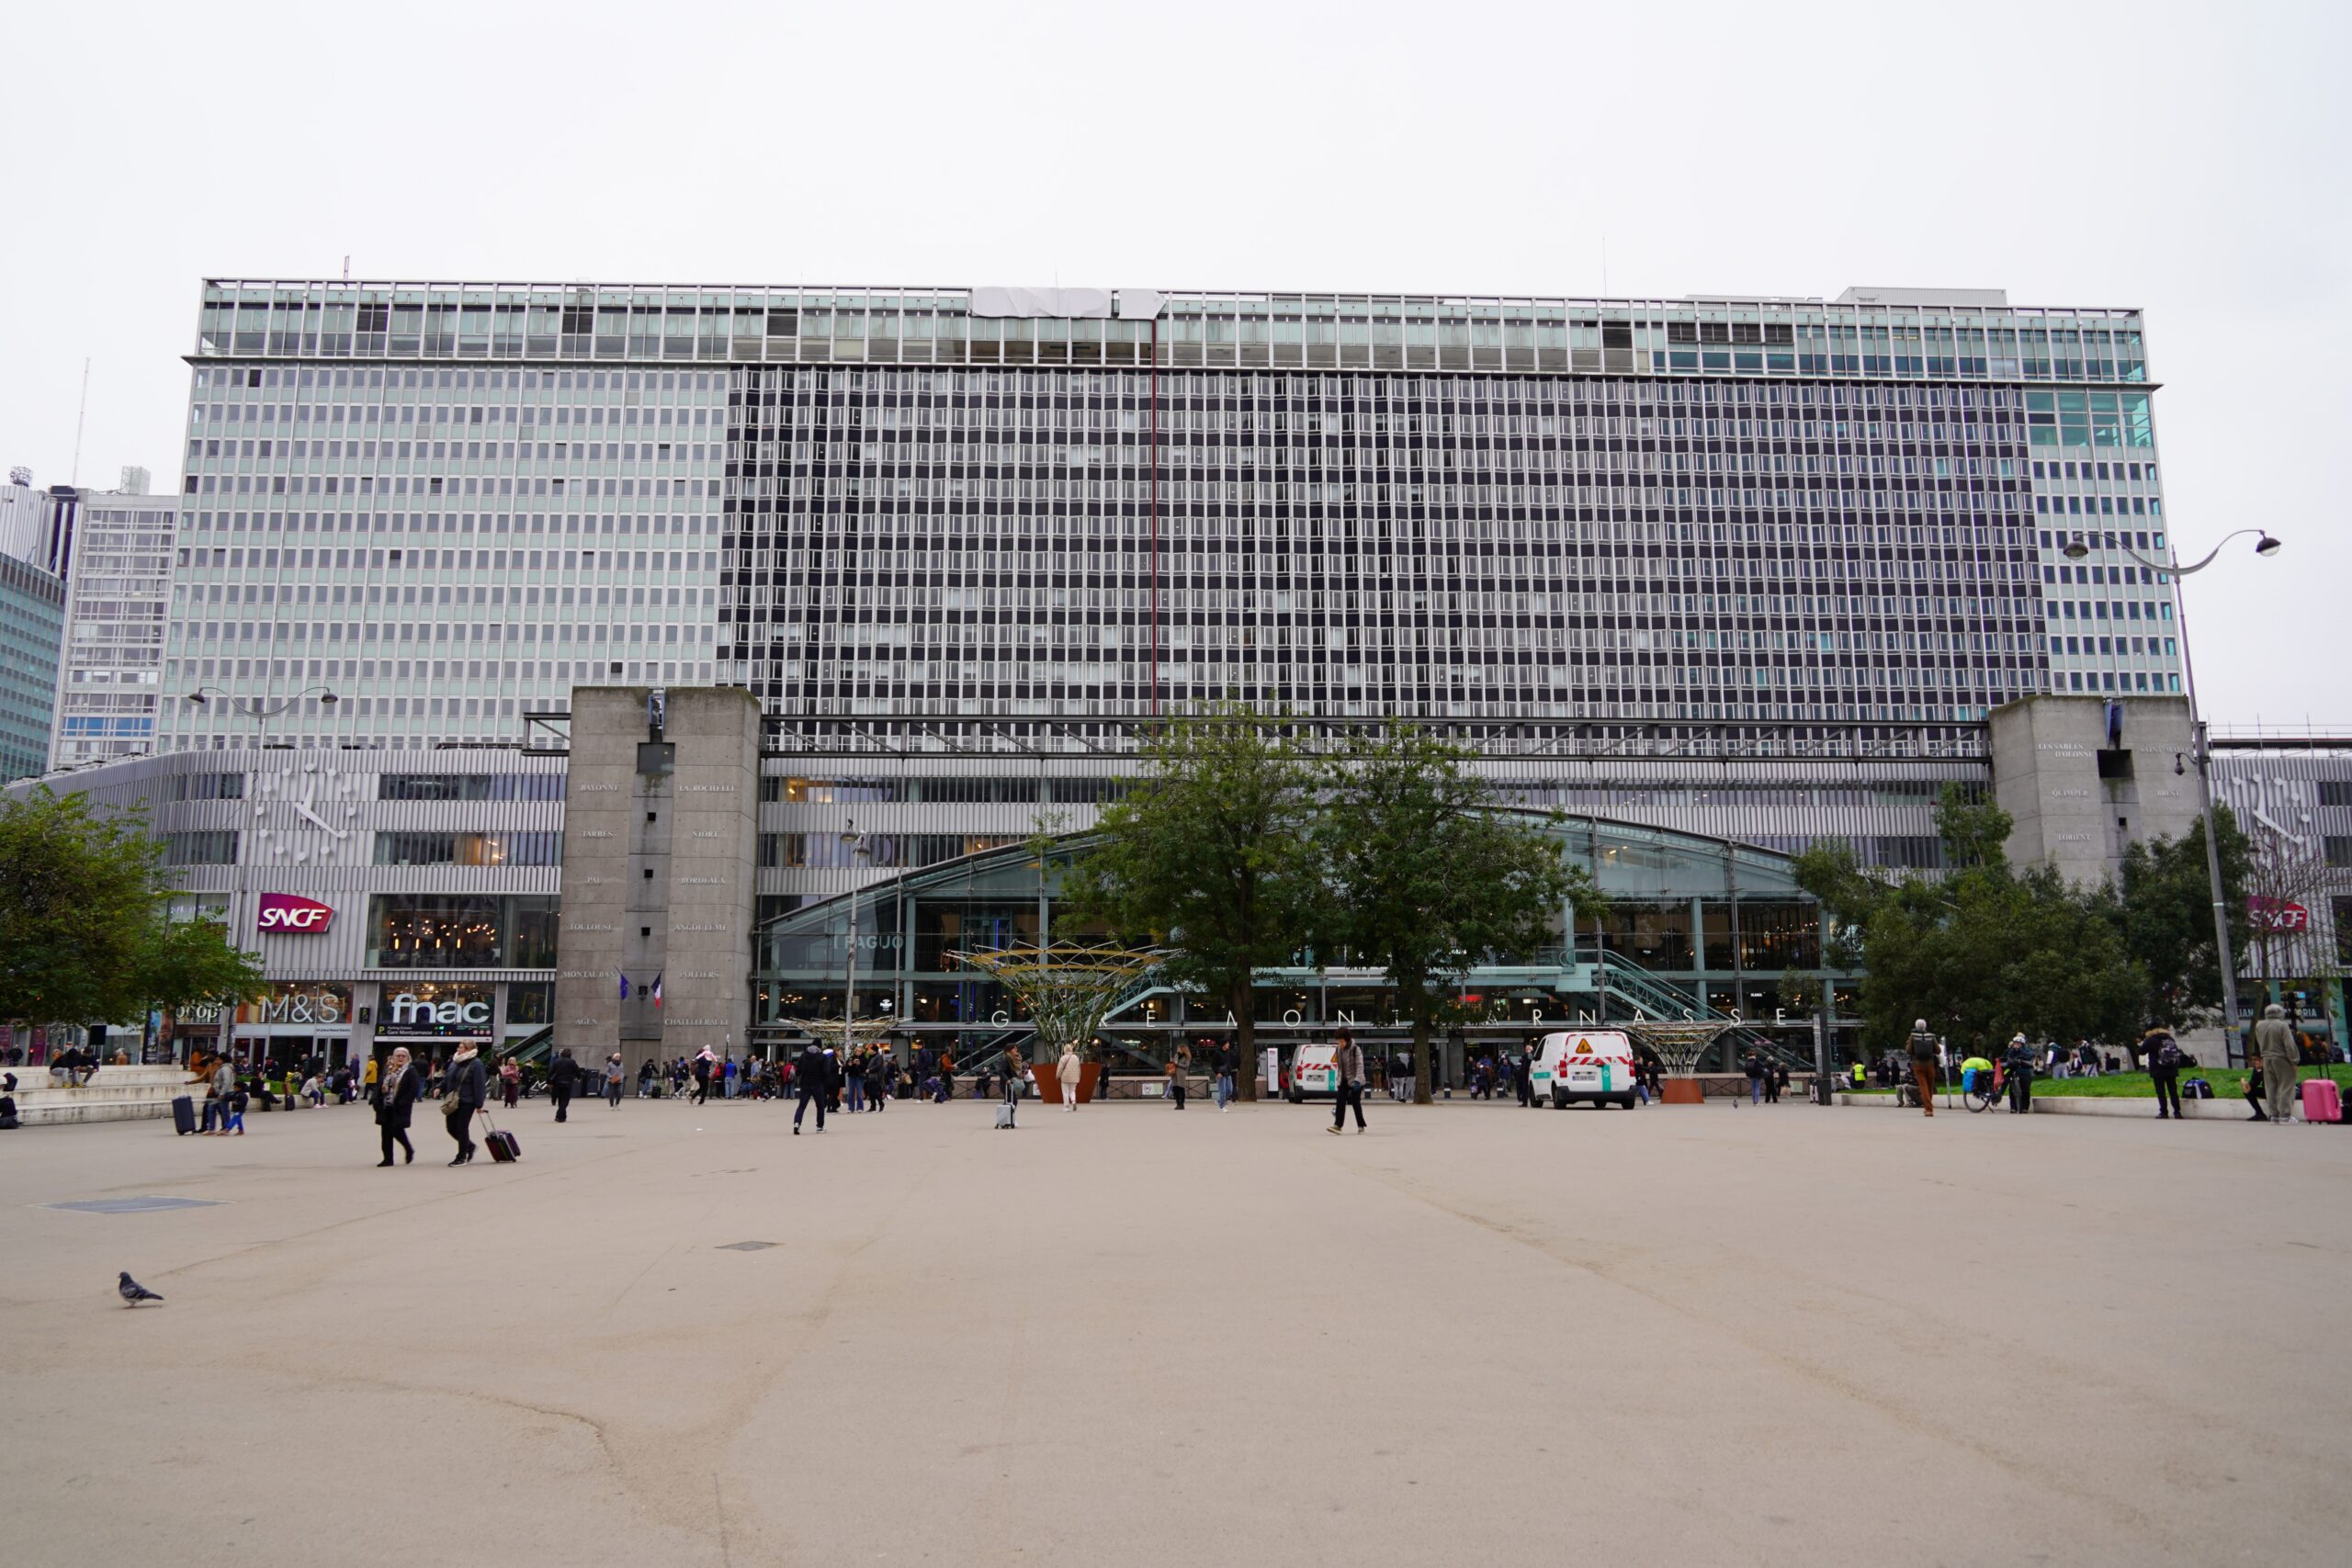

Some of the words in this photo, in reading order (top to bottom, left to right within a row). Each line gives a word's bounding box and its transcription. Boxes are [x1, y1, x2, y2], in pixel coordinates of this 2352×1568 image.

[581, 784, 618, 792] BAYONNE
[2052, 789, 2088, 797] QUIMPER
[259, 908, 327, 928] SNCF
[680, 971, 720, 979] POITIERS
[261, 993, 339, 1023] M&S
[390, 993, 492, 1024] fnac
